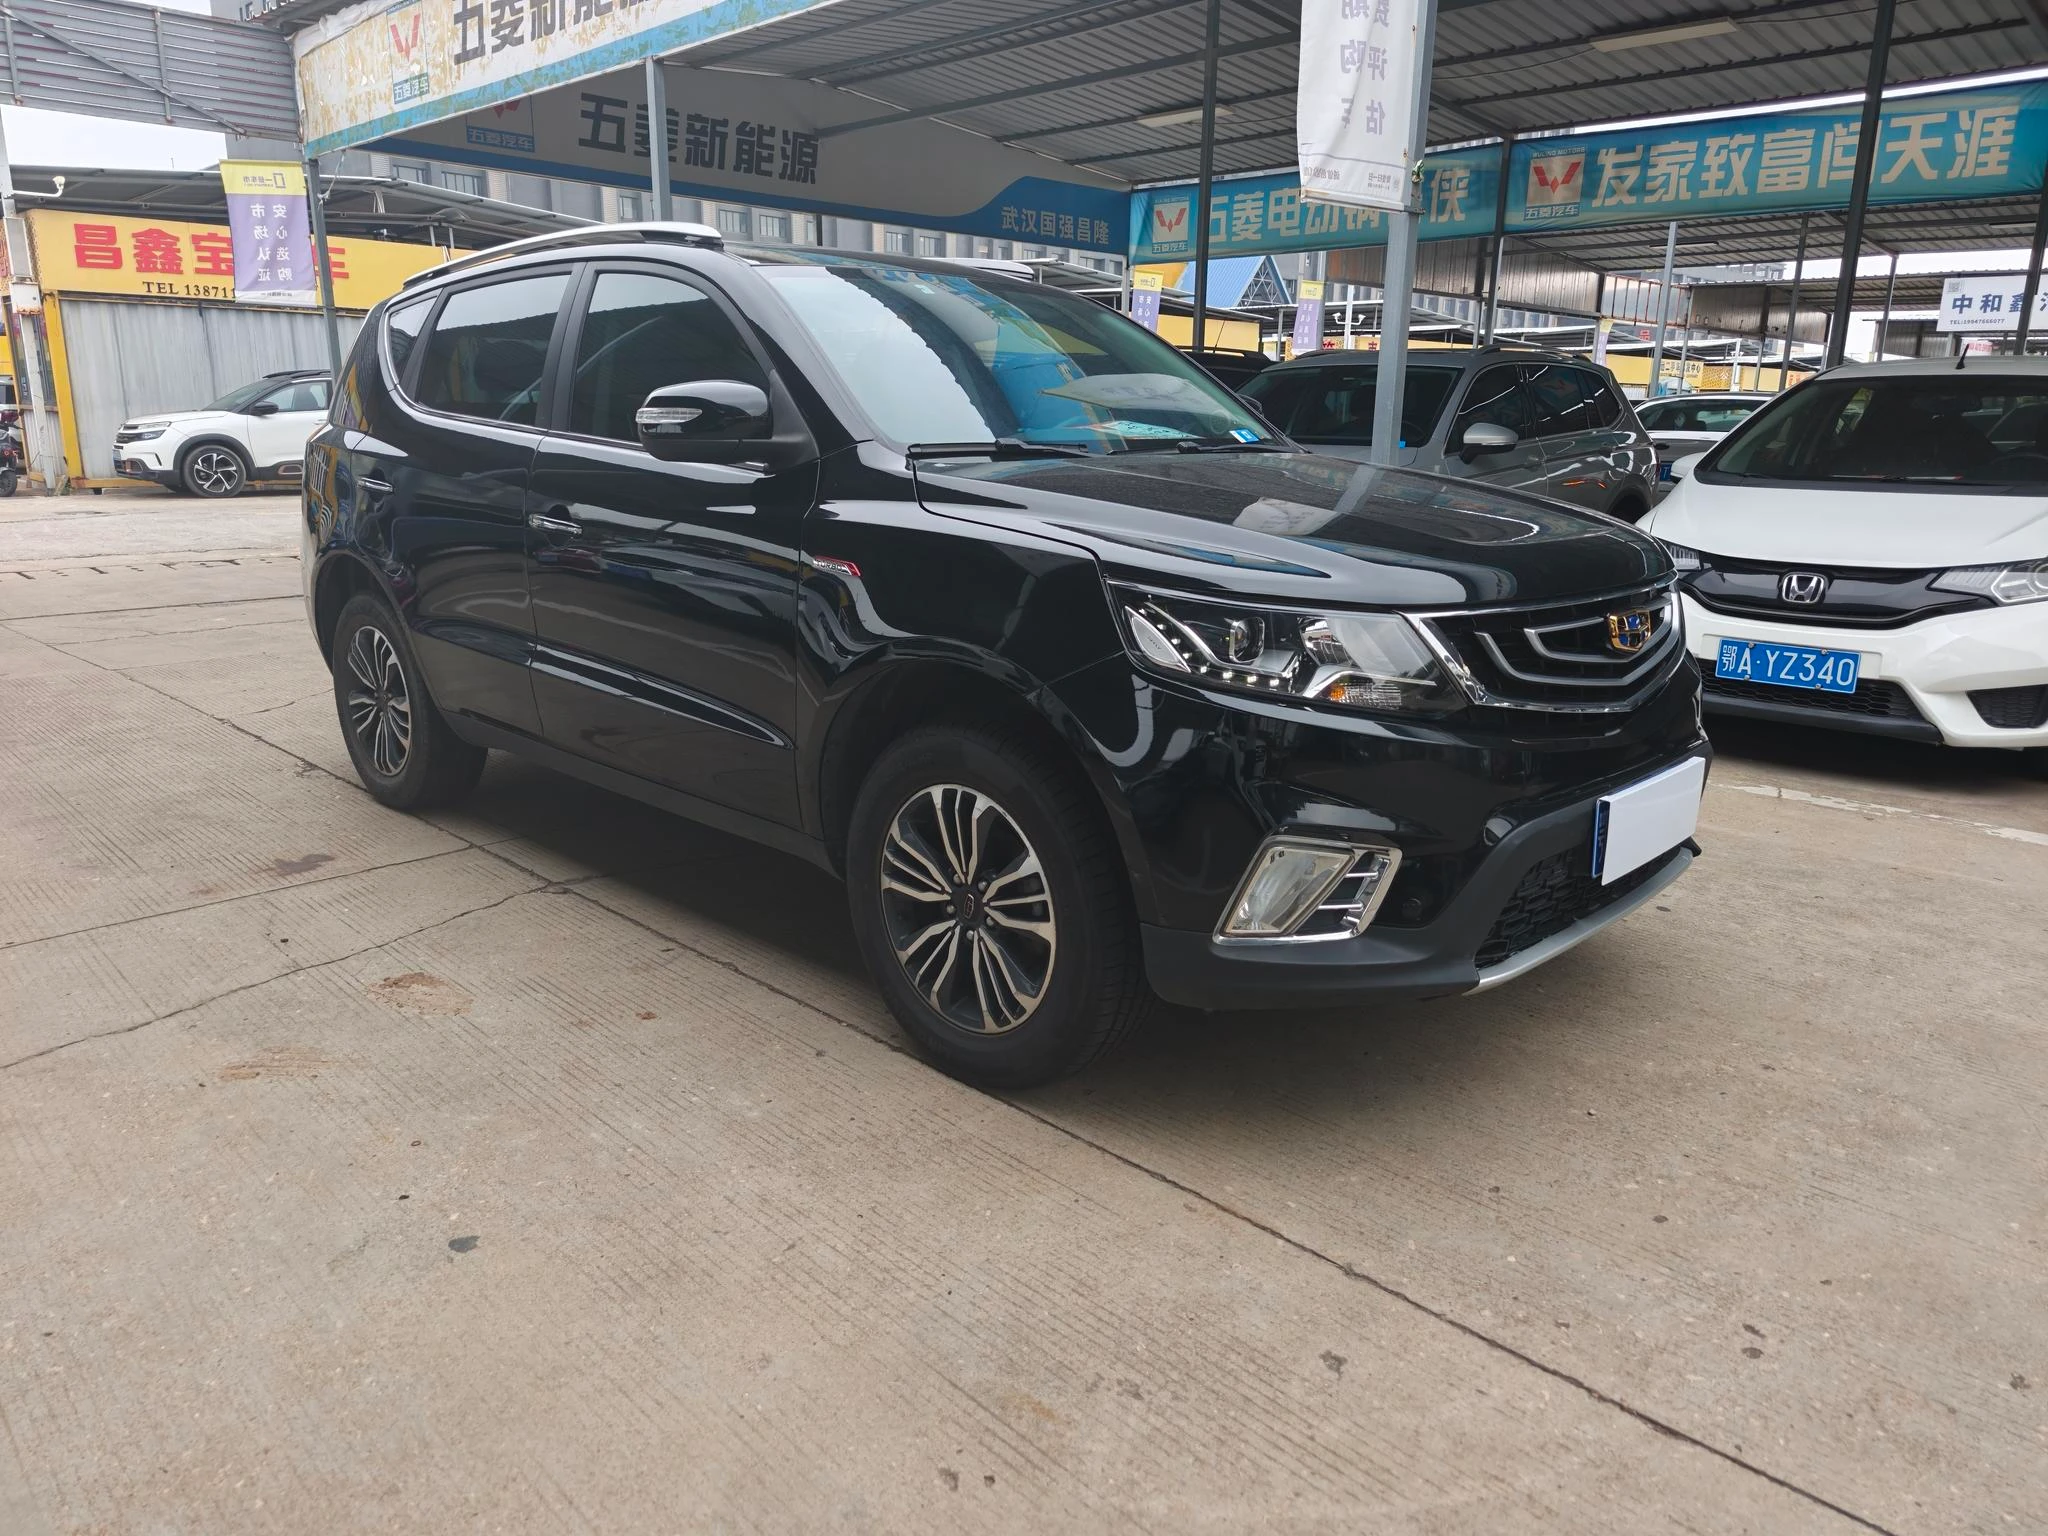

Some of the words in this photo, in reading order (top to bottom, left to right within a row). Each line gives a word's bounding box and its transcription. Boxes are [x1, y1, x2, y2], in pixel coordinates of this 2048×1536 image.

[467, 128, 533, 149] 五菱汽车
[578, 92, 819, 184] 五菱新能源
[1592, 106, 2018, 208] 发家致富闯天涯
[1002, 206, 1109, 245] 武汉国强昌隆
[1526, 204, 1579, 219] 五菱汽车
[74, 223, 349, 281] 昌鑫宝车
[142, 281, 179, 295] TEL
[1952, 292, 2048, 314] 中和鑫
[1722, 645, 1855, 686] 鄂A·YZ340
